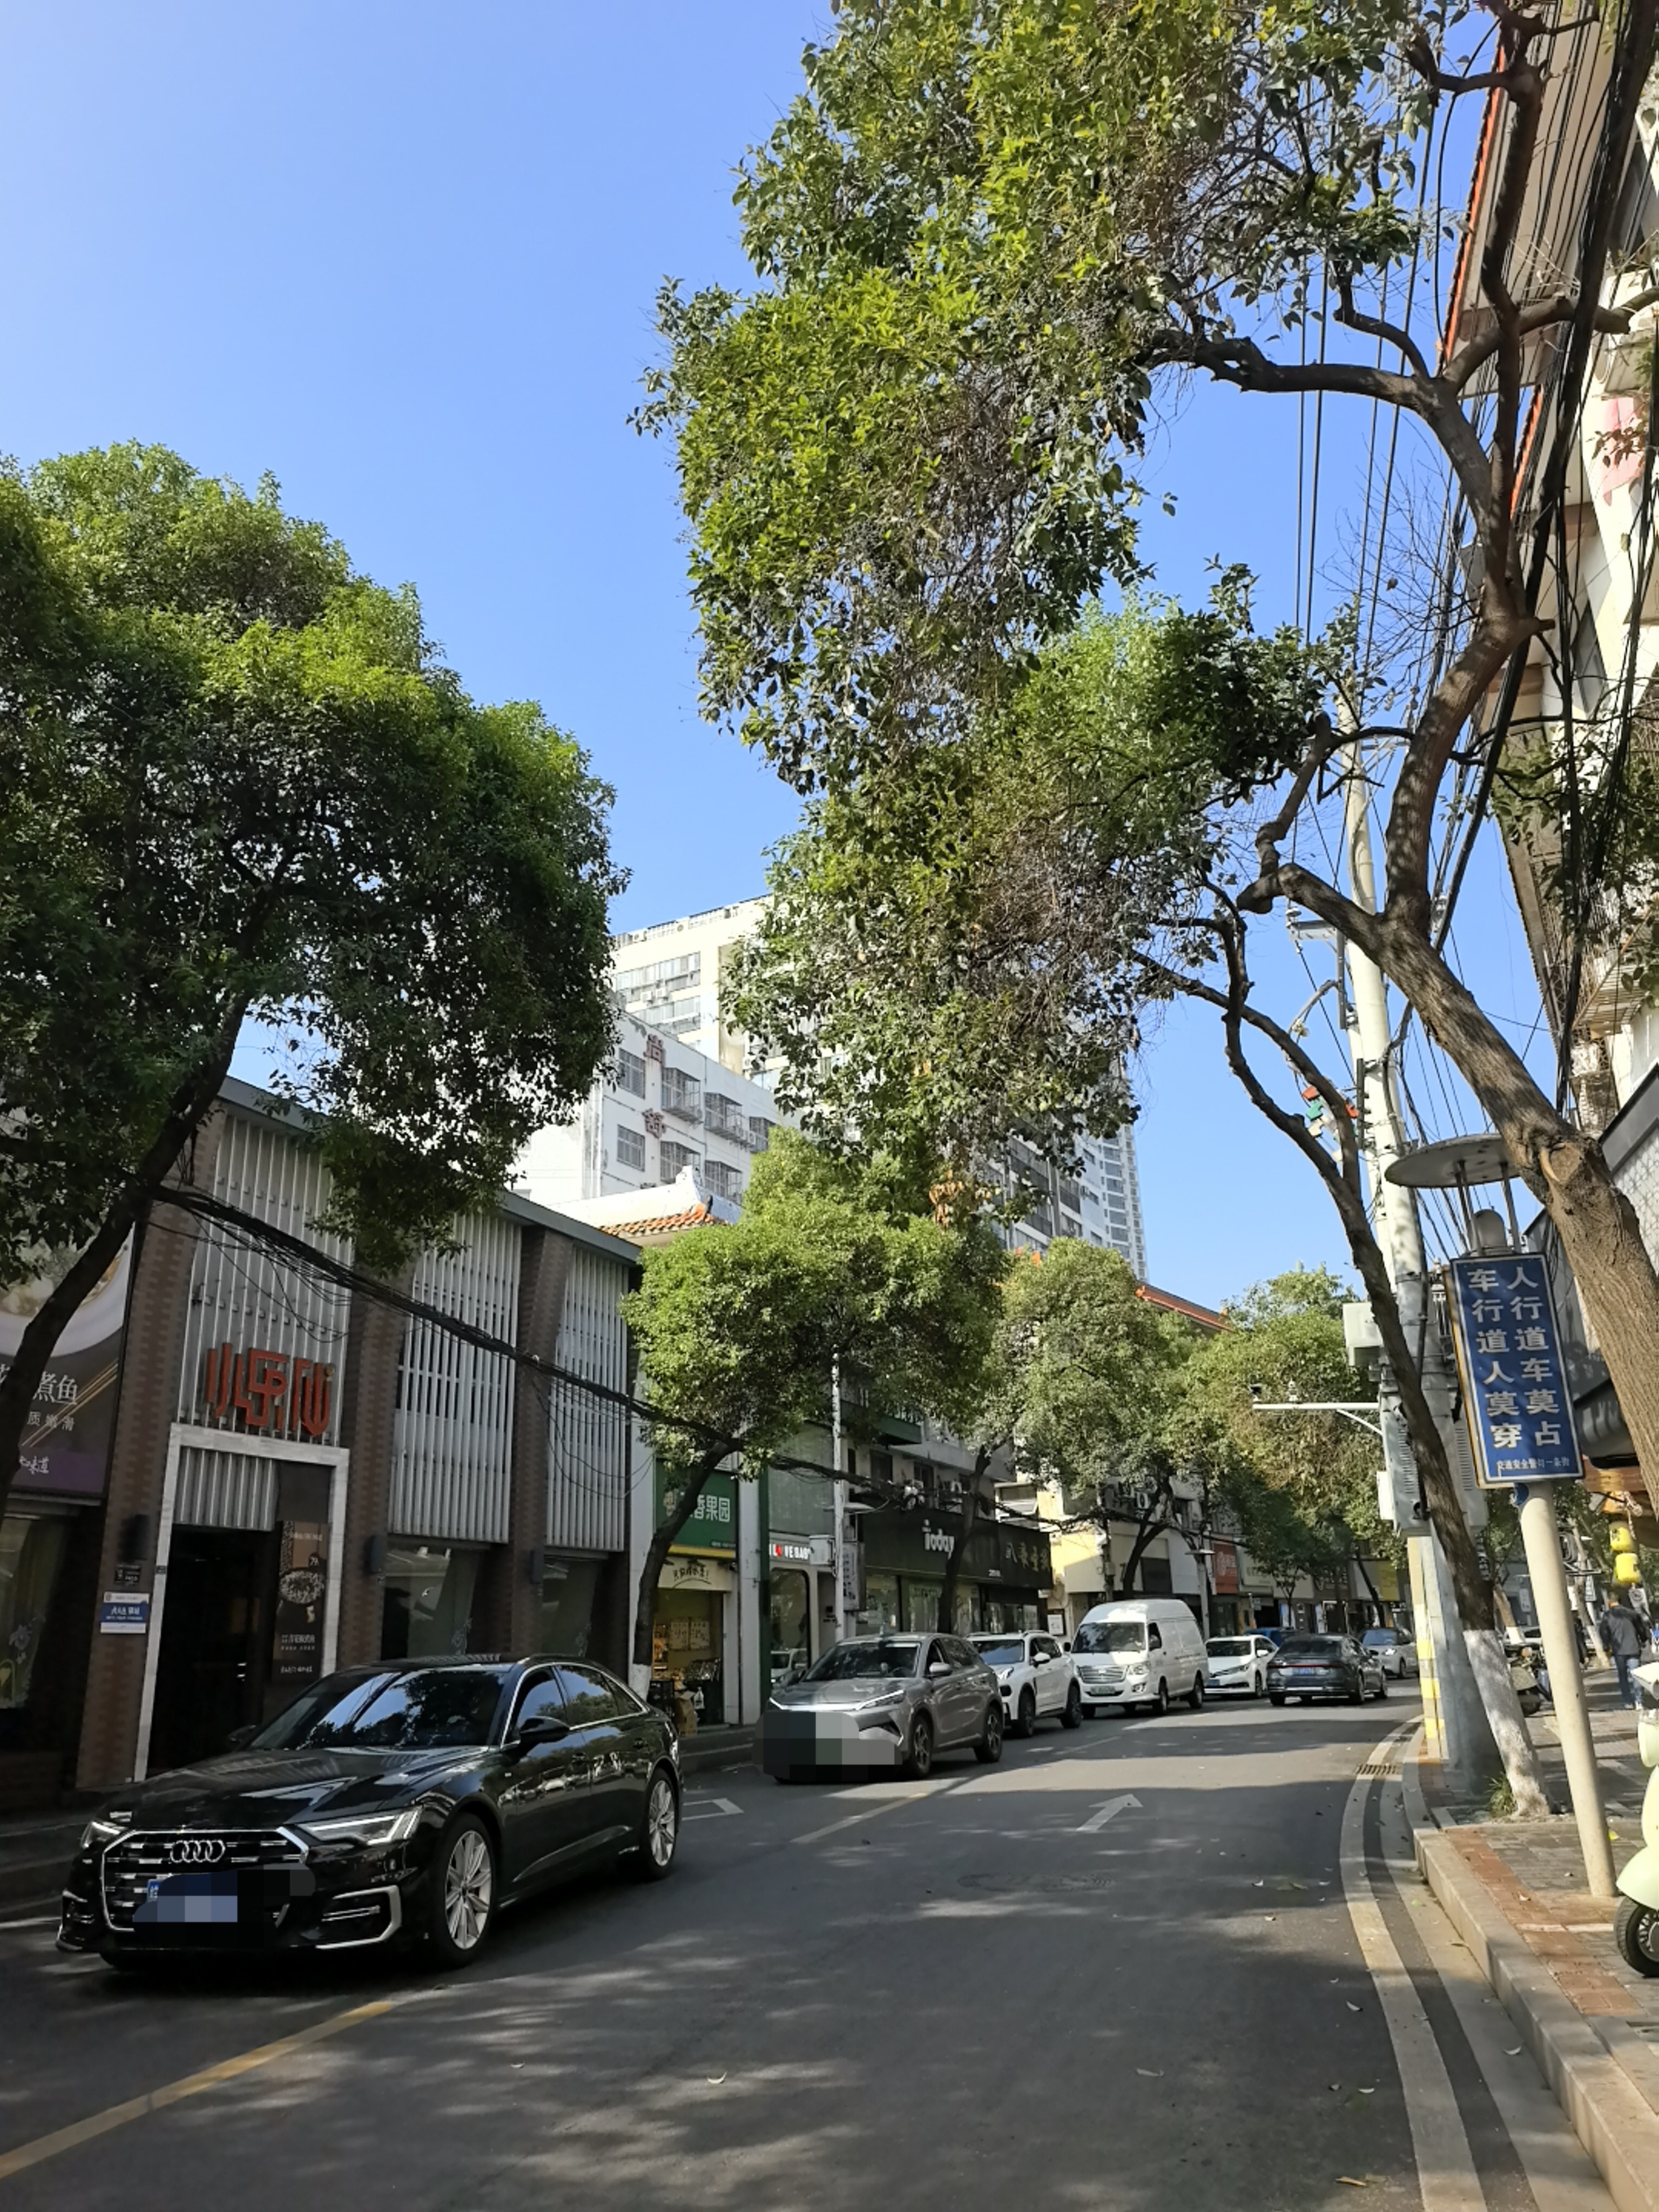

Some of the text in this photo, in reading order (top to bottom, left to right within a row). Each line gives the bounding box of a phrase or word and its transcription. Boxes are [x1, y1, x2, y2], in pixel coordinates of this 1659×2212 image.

[1468, 1267, 1523, 1449] 车行道人莫穿
[1506, 1267, 1562, 1448] 人行道车莫占
[688, 1494, 731, 1523] 香果园
